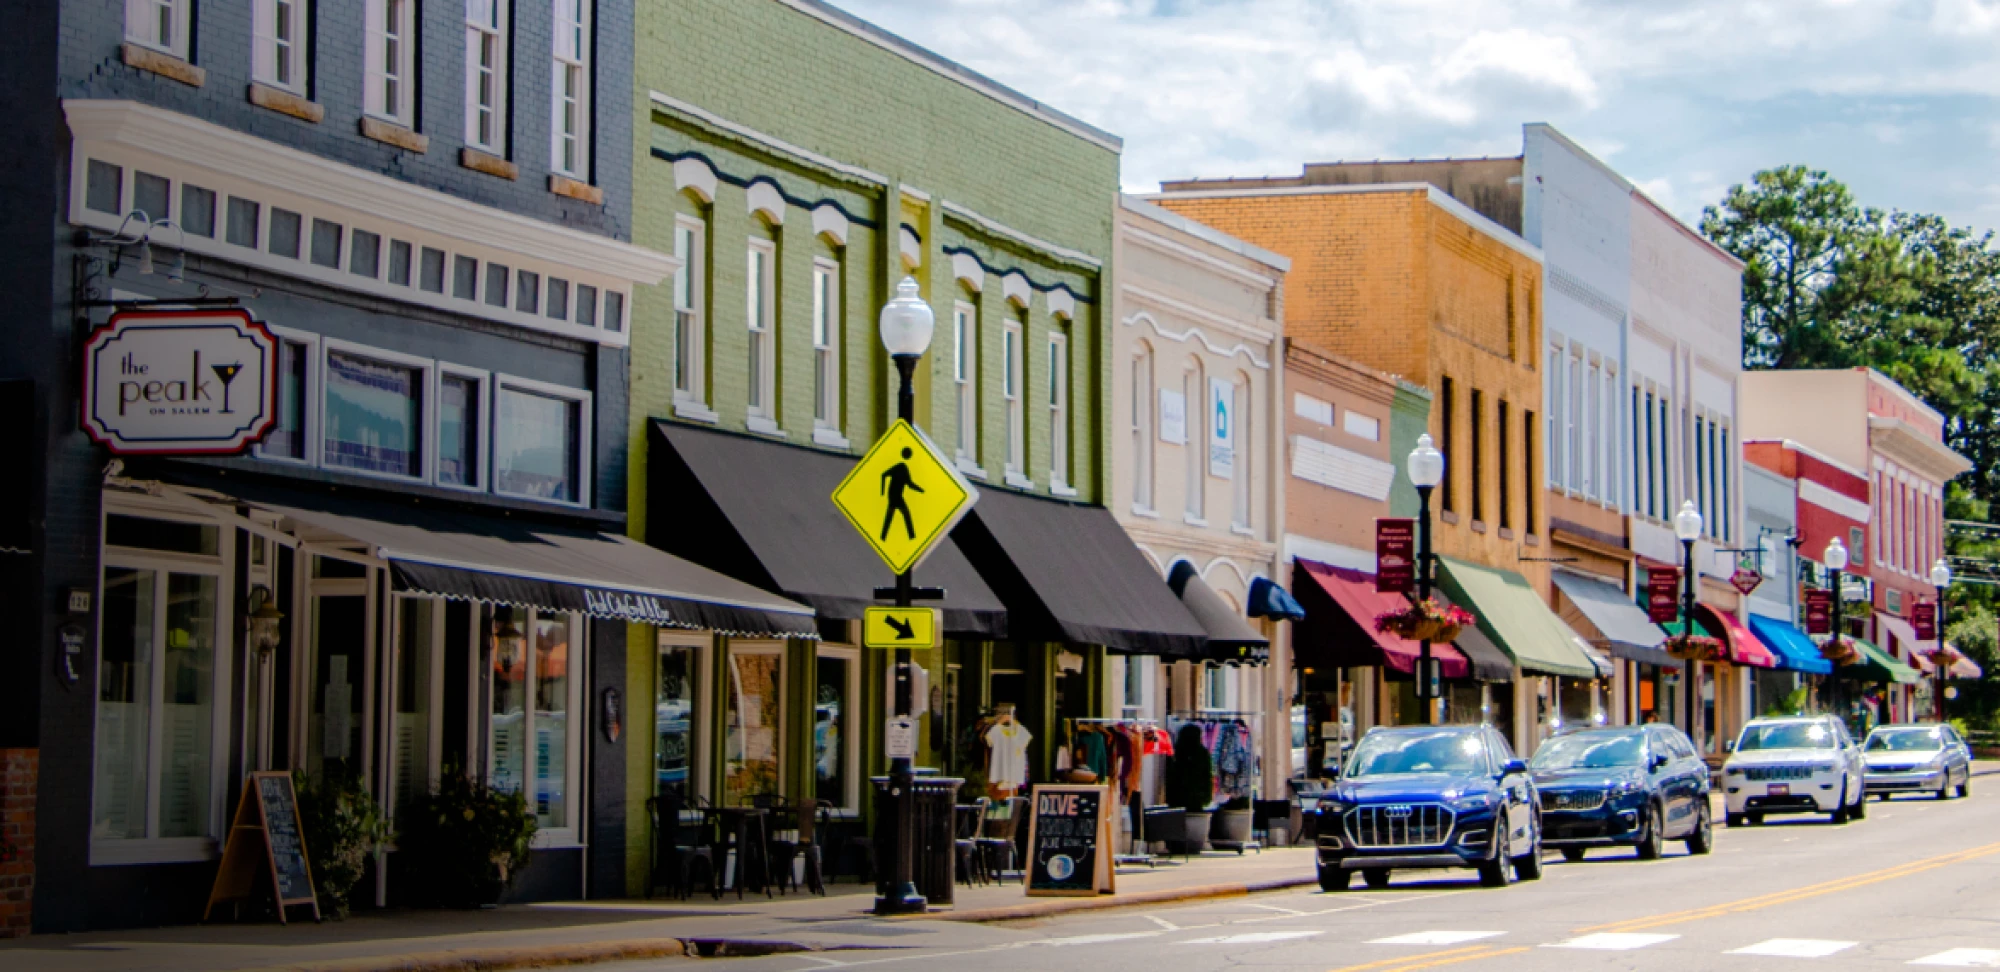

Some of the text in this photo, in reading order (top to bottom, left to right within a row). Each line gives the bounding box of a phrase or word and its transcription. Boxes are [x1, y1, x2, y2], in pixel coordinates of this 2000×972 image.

[121, 352, 148, 374] the
[118, 350, 212, 416] peak
[149, 407, 211, 415] ON SALEM
[1040, 794, 1079, 815] DIVE
